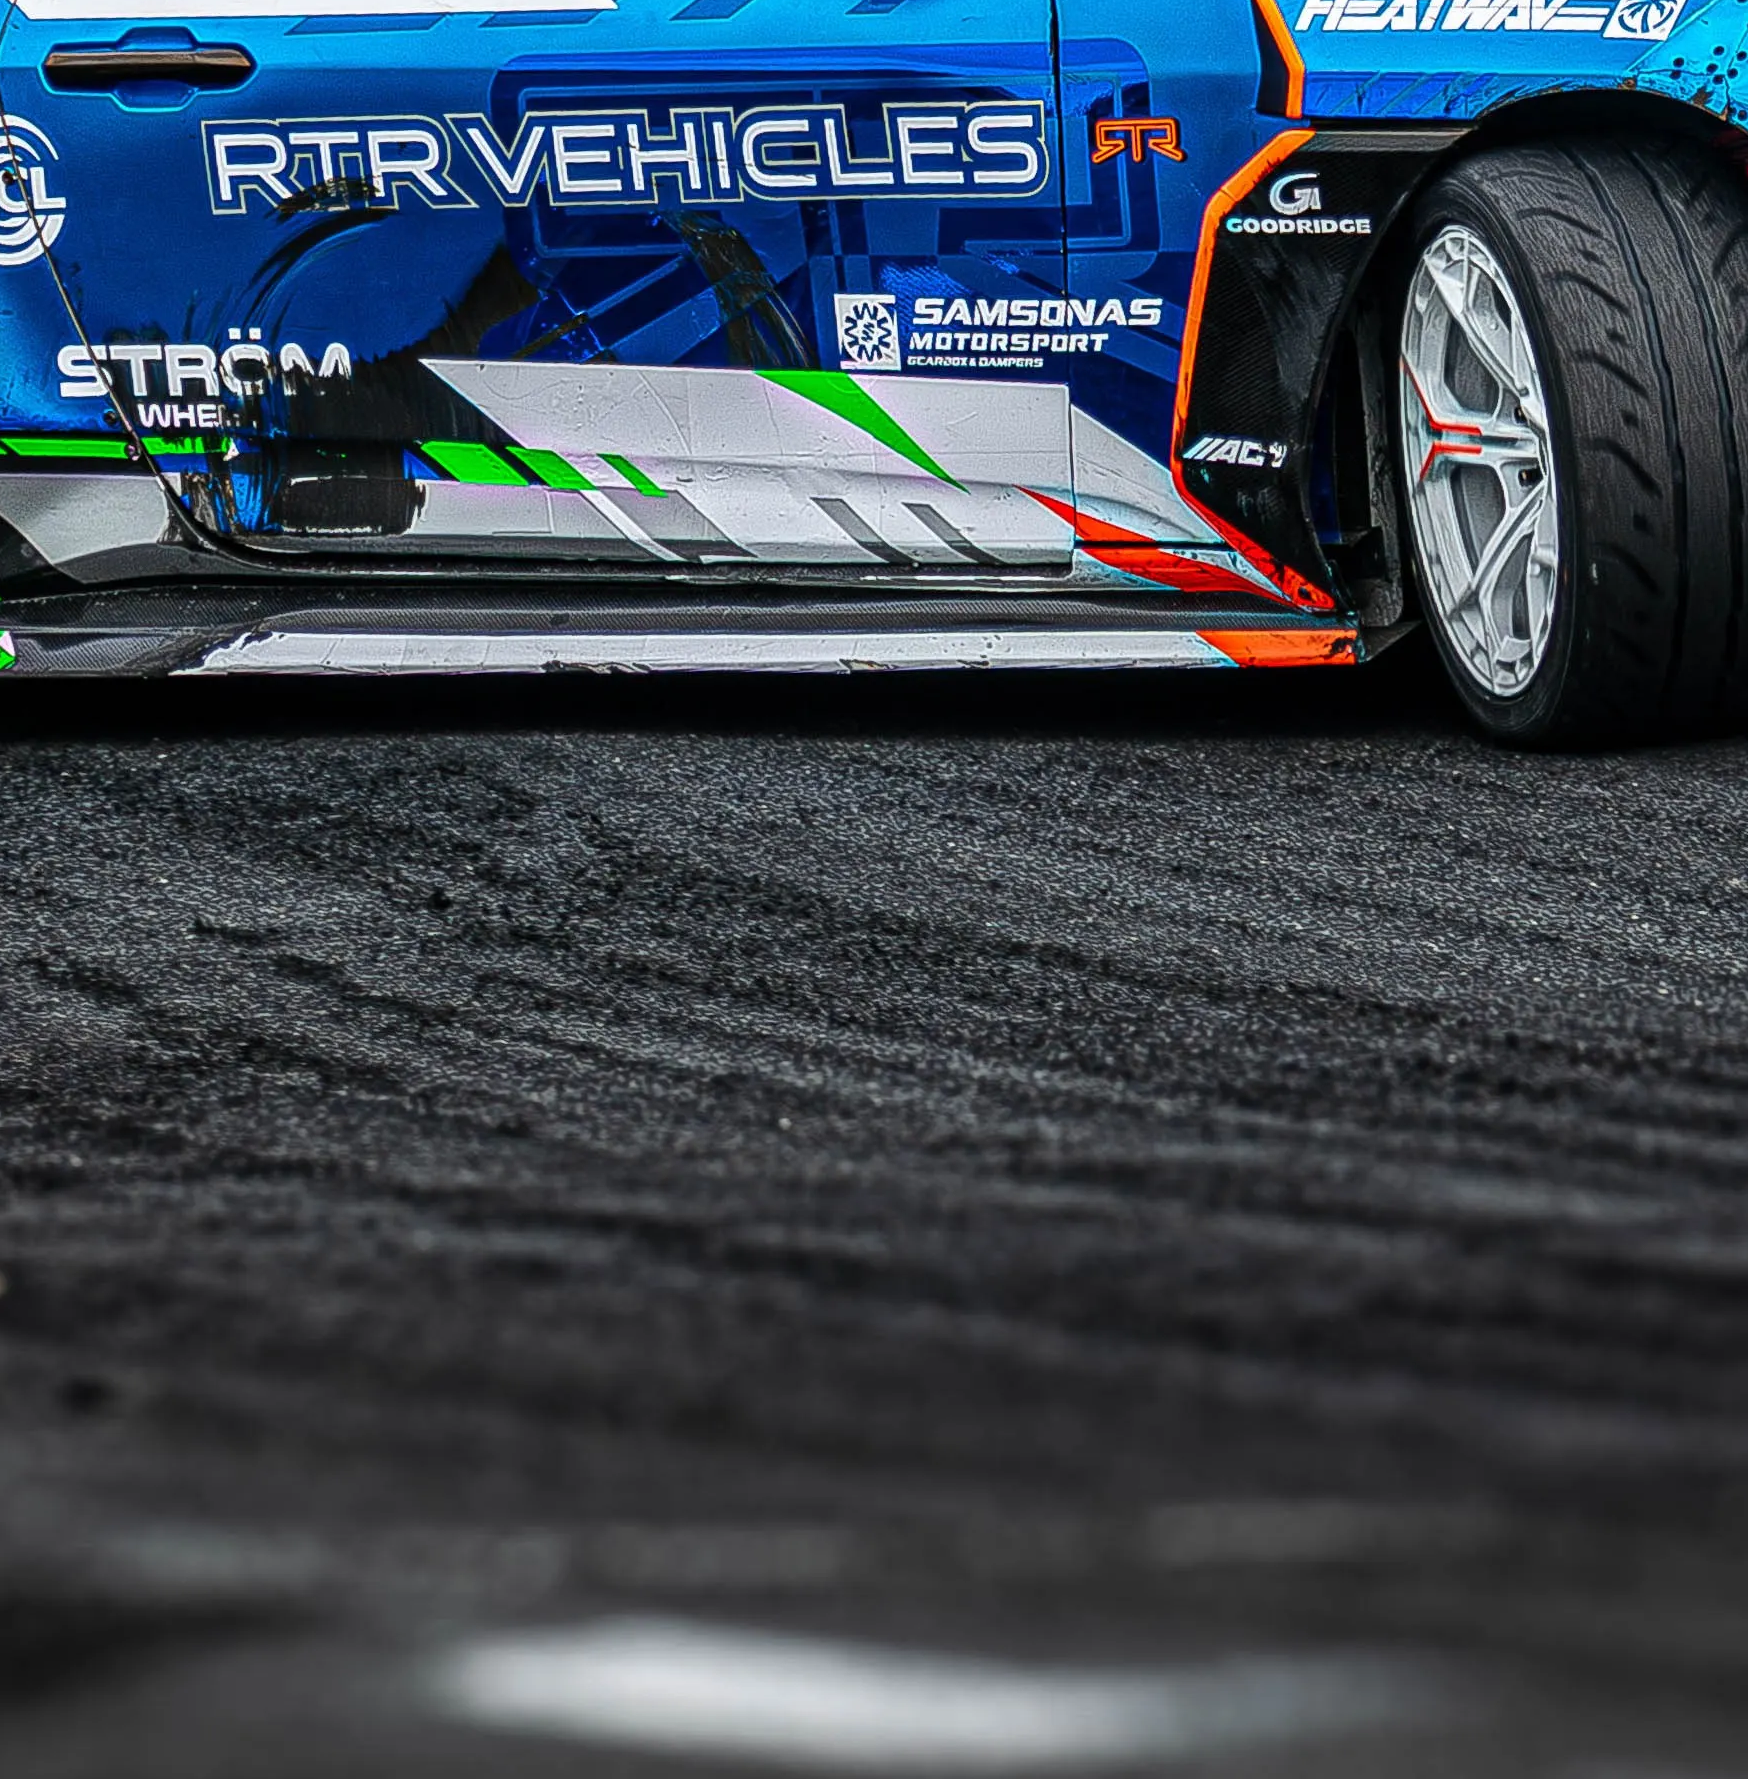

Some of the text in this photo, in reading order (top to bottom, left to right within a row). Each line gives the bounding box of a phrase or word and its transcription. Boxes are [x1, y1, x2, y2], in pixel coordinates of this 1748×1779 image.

[205, 103, 1046, 211] RTR VEHICLES
[1226, 218, 1372, 234] GOODRIDGE
[913, 298, 1163, 326] SAMSONAS
[908, 332, 1109, 353] MOTORSPORT
[978, 357, 1044, 369] DAMPERS
